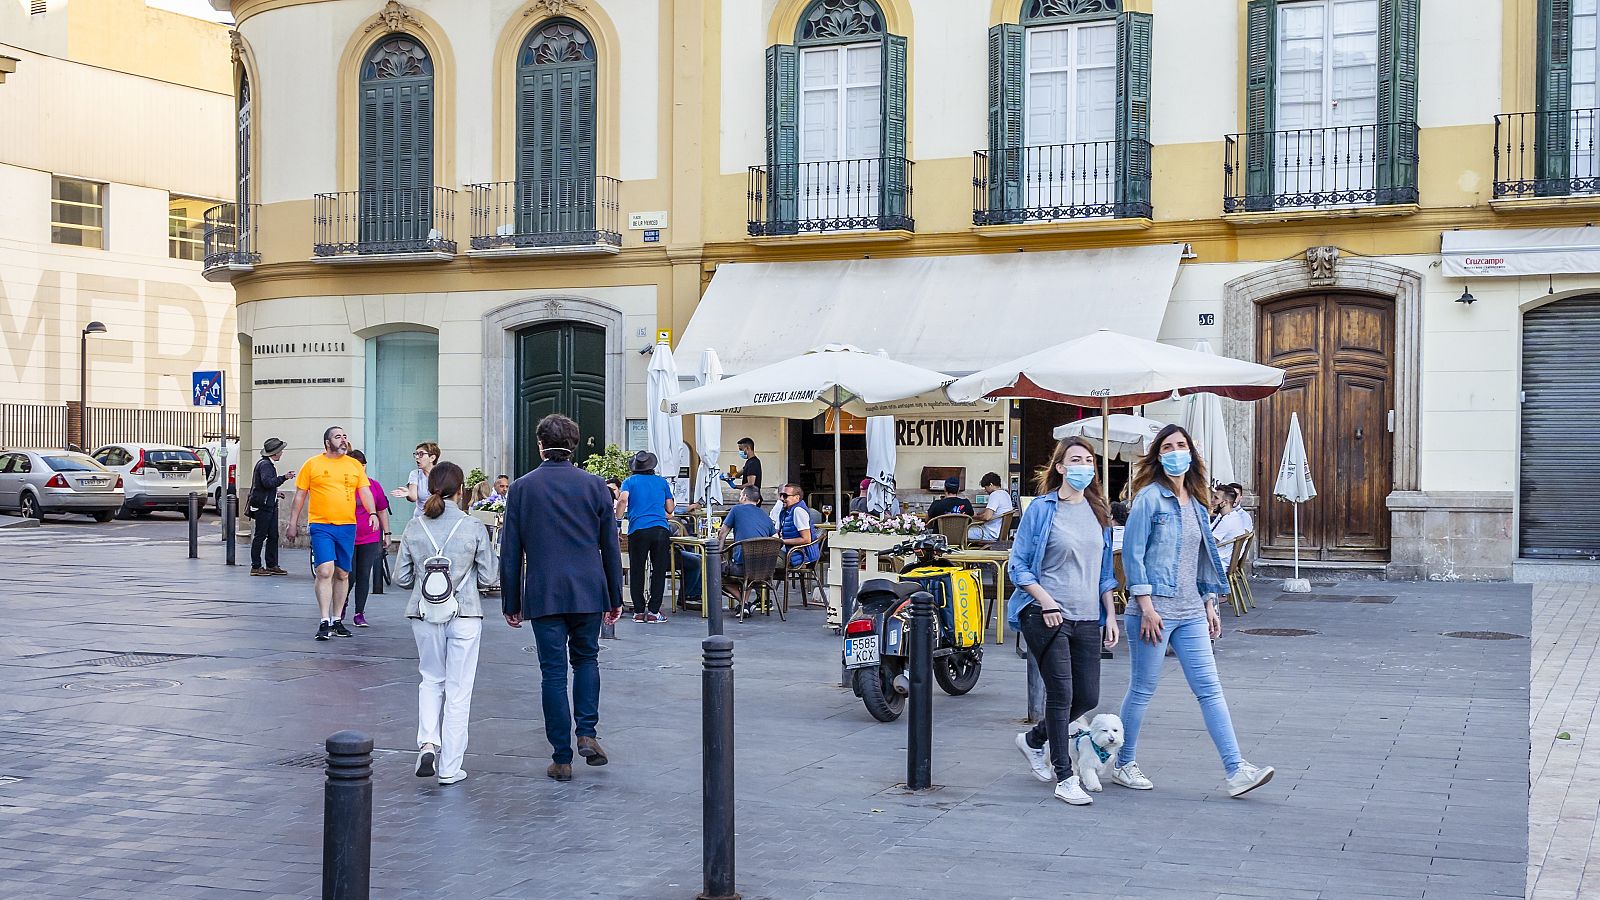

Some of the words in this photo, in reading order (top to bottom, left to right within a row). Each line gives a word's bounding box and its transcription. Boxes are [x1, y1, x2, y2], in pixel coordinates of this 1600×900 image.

[1465, 257, 1504, 266] Cruzcampo
[302, 340, 345, 353] PICASSO
[753, 391, 789, 403] CERVEZAS
[895, 419, 1004, 447] RESTAURANTE
[958, 578, 969, 631] Glovo
[852, 637, 876, 651] 5585
[856, 649, 874, 662] KCX
